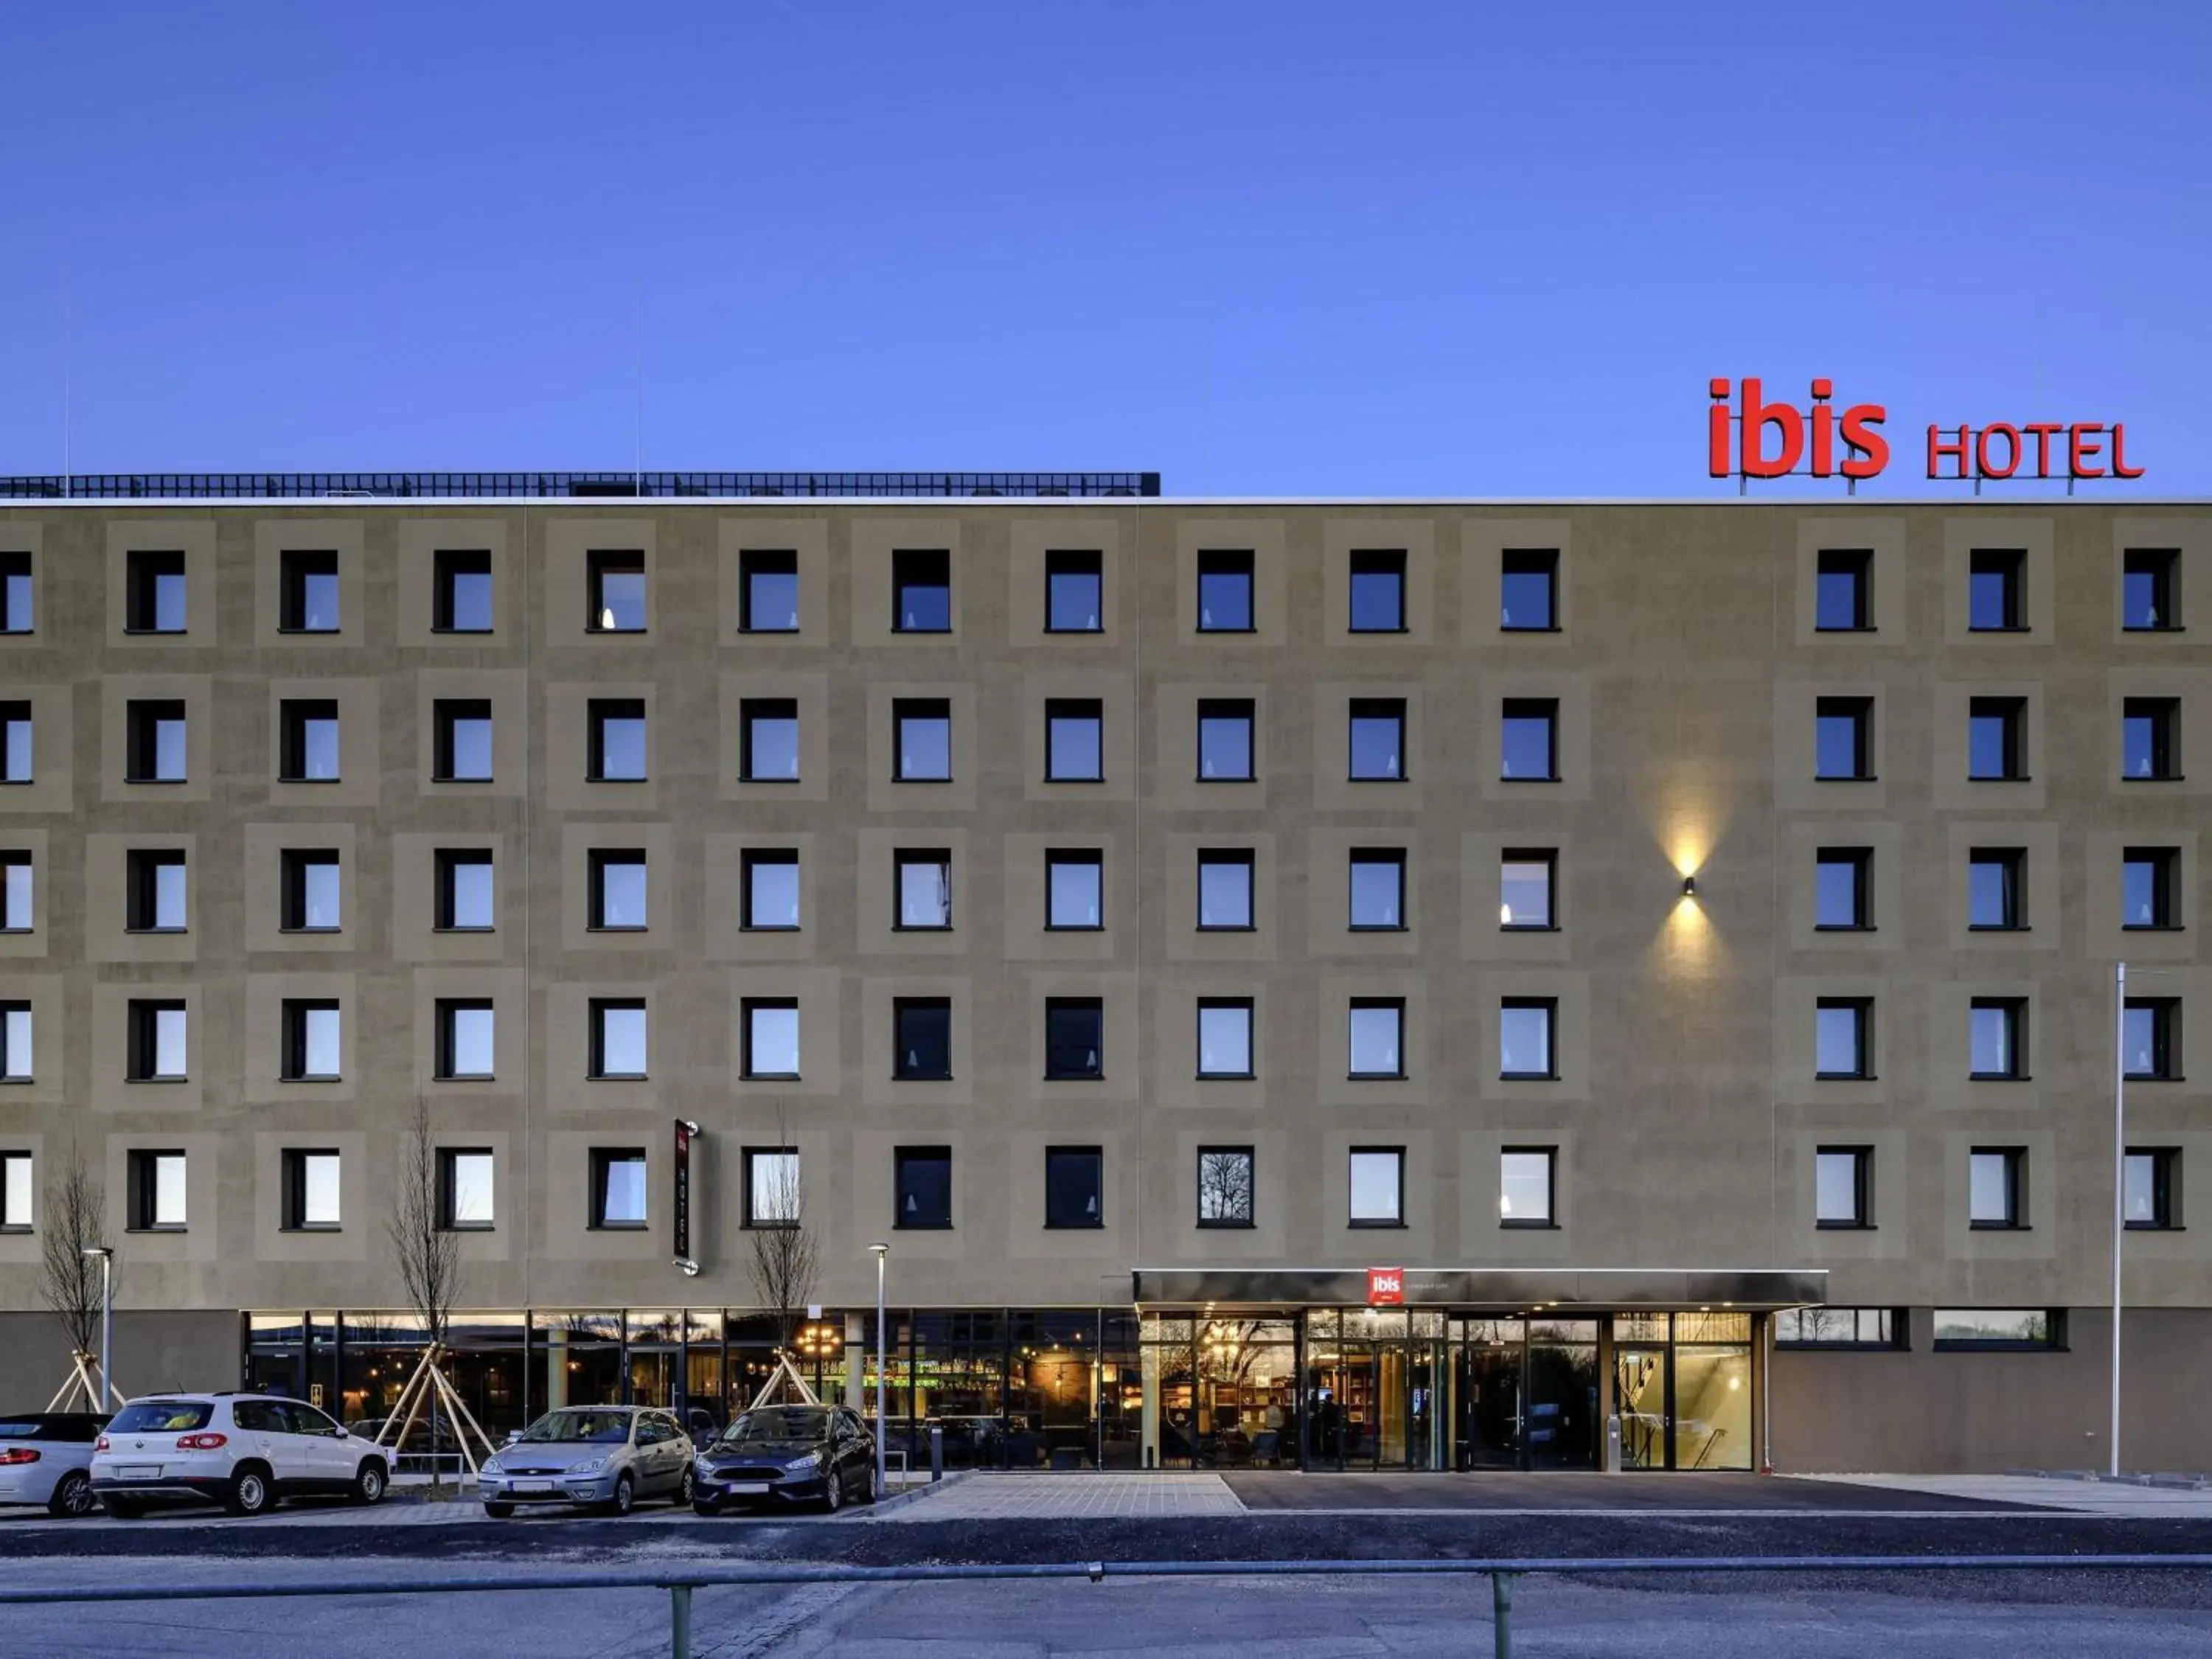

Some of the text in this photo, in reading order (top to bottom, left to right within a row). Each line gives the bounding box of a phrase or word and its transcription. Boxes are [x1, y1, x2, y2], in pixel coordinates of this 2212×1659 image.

[1709, 378, 2146, 479] ibis HOTEL
[1373, 1276, 1401, 1293] ibis
